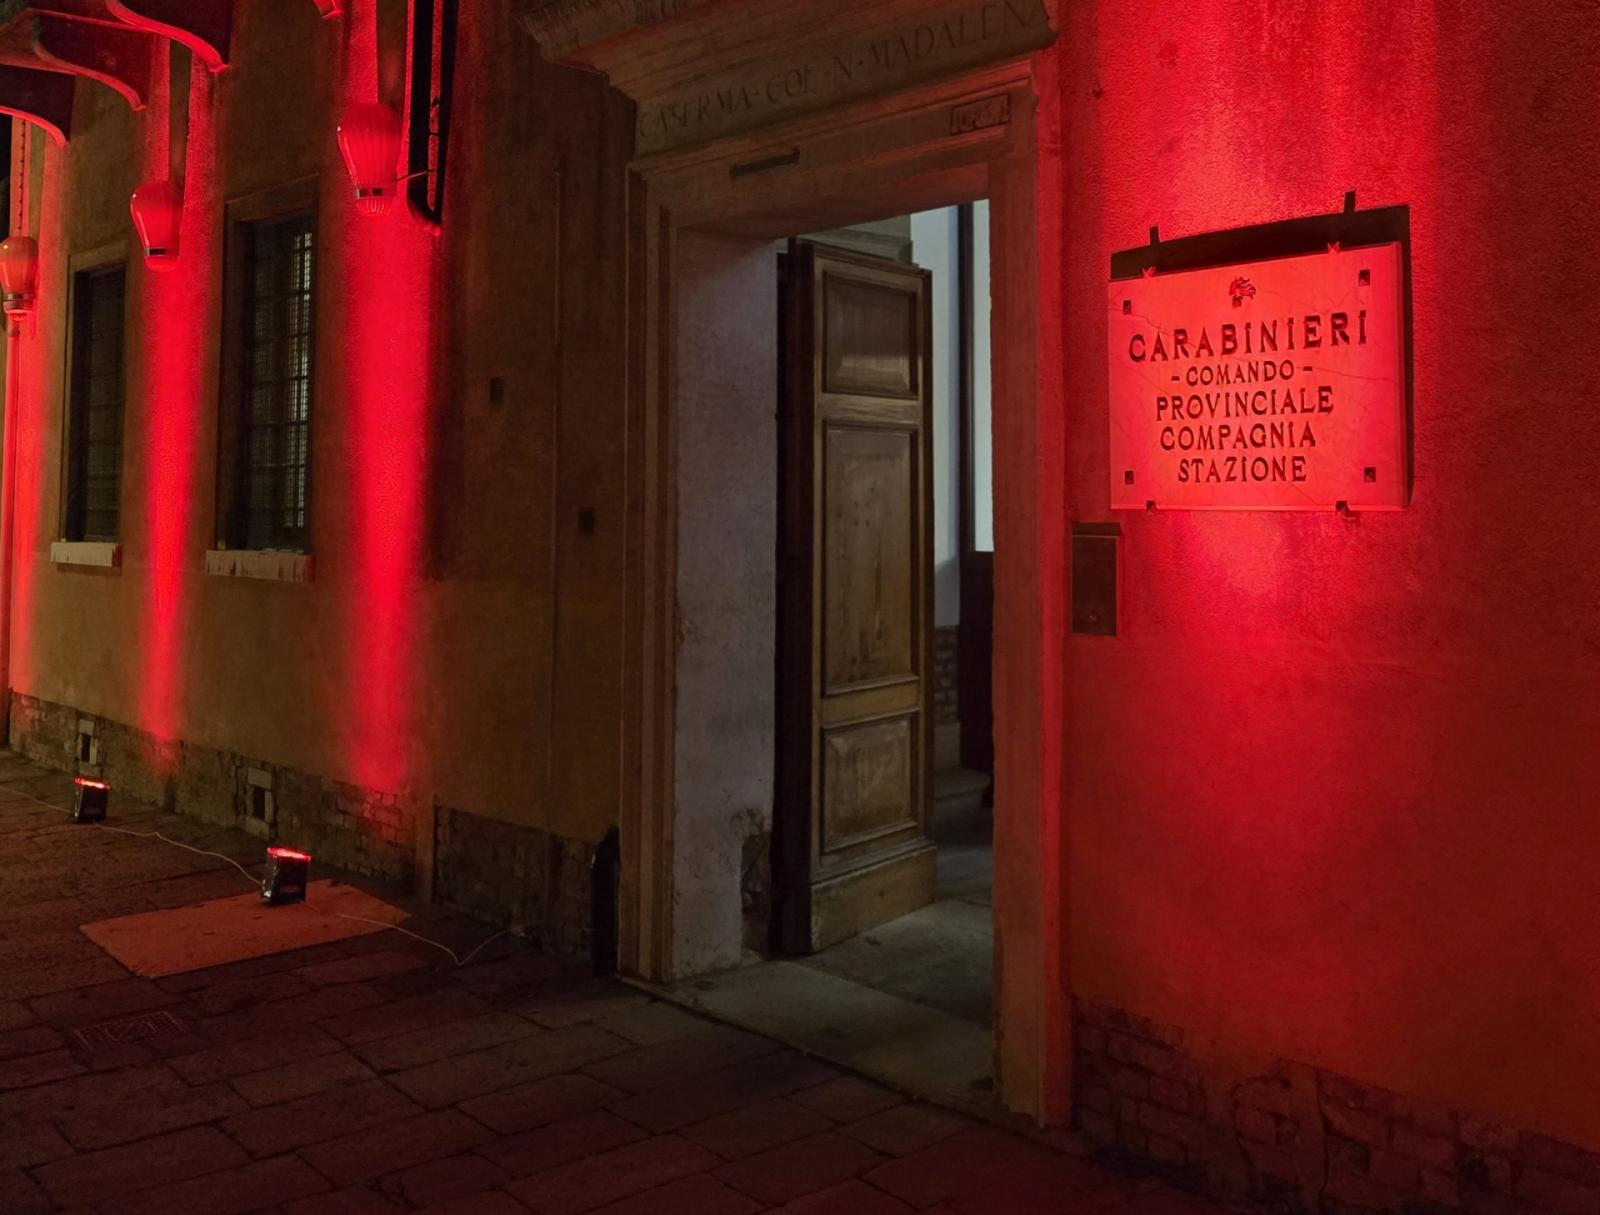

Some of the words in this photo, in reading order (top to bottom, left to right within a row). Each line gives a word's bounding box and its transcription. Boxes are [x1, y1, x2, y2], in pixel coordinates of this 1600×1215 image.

[1128, 310, 1367, 363] CARABINIERI
[1155, 386, 1334, 421] PROVINCIALE
[1160, 421, 1316, 451] COMPAGNIA
[1177, 455, 1308, 483] STAZIONE
